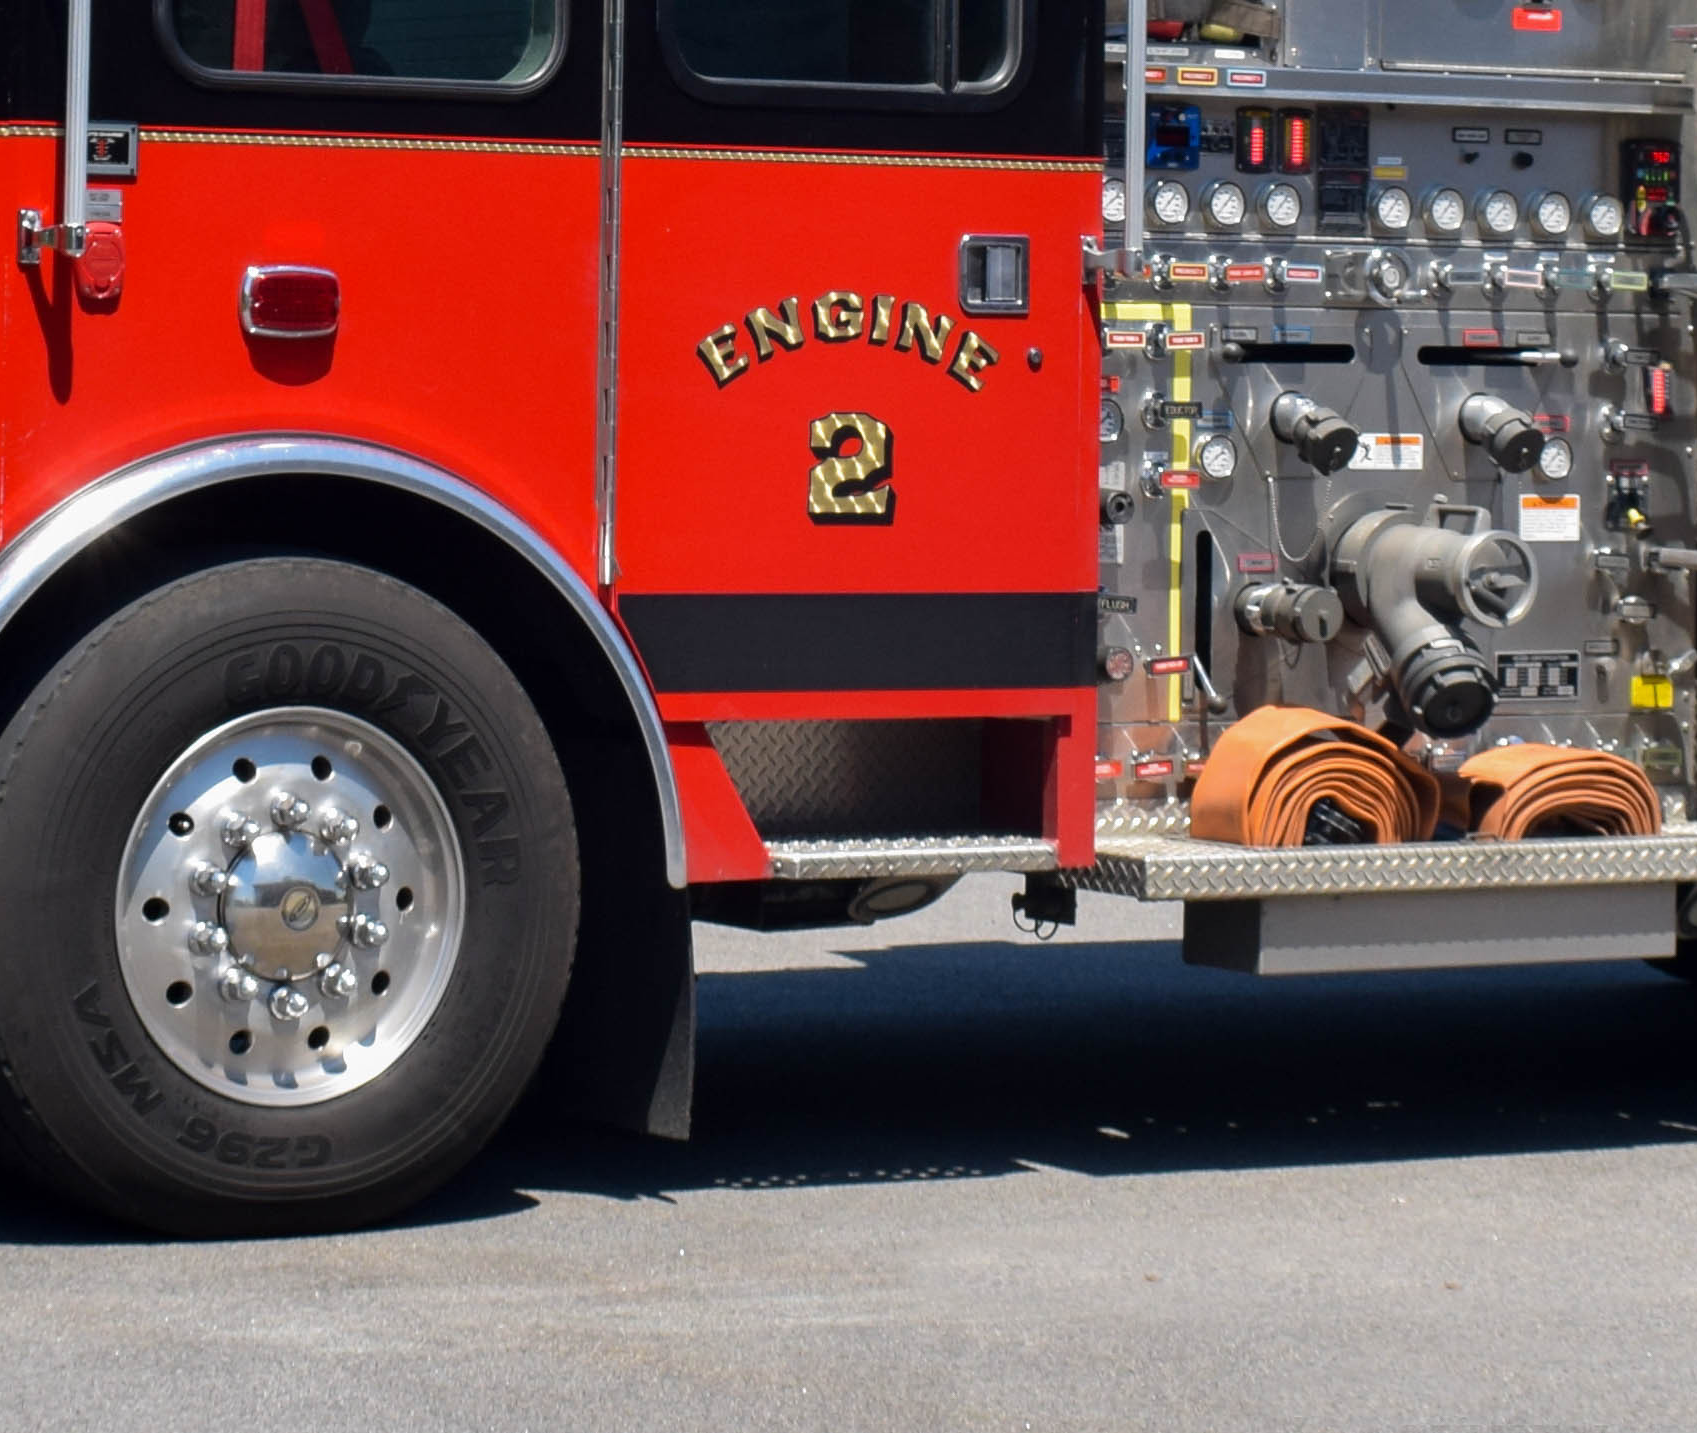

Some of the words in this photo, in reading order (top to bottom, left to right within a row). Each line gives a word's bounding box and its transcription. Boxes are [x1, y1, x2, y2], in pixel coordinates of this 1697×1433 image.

[696, 289, 1001, 393] ENGINE
[806, 411, 897, 526] 2
[221, 642, 520, 890] GOODYEAR
[72, 981, 165, 1115] MSA
[177, 1113, 333, 1170] G296
